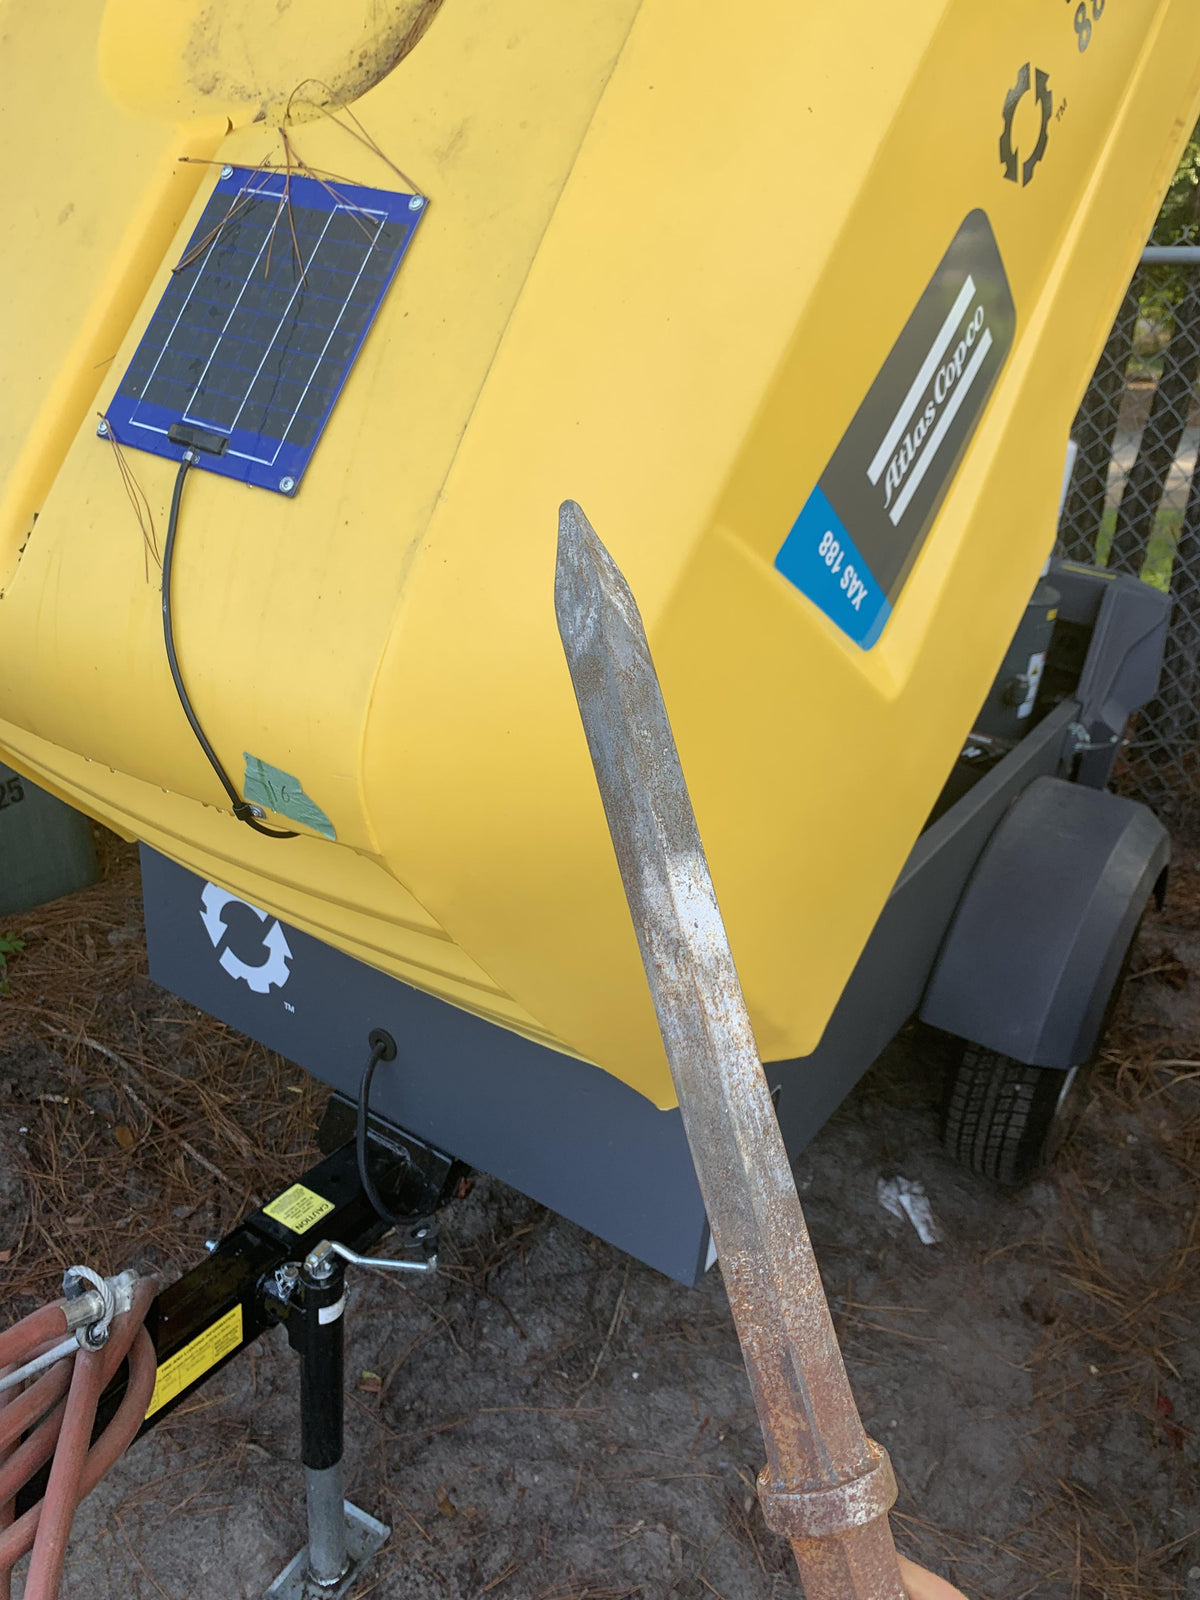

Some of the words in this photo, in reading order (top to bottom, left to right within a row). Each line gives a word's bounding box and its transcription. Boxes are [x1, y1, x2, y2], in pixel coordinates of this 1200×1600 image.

[883, 400, 936, 509] Atlas
[934, 305, 984, 404] Copco
[818, 530, 844, 574] 188
[840, 565, 868, 611] XAS
[283, 1000, 295, 1014] TM
[295, 1203, 329, 1230] CAUTION
